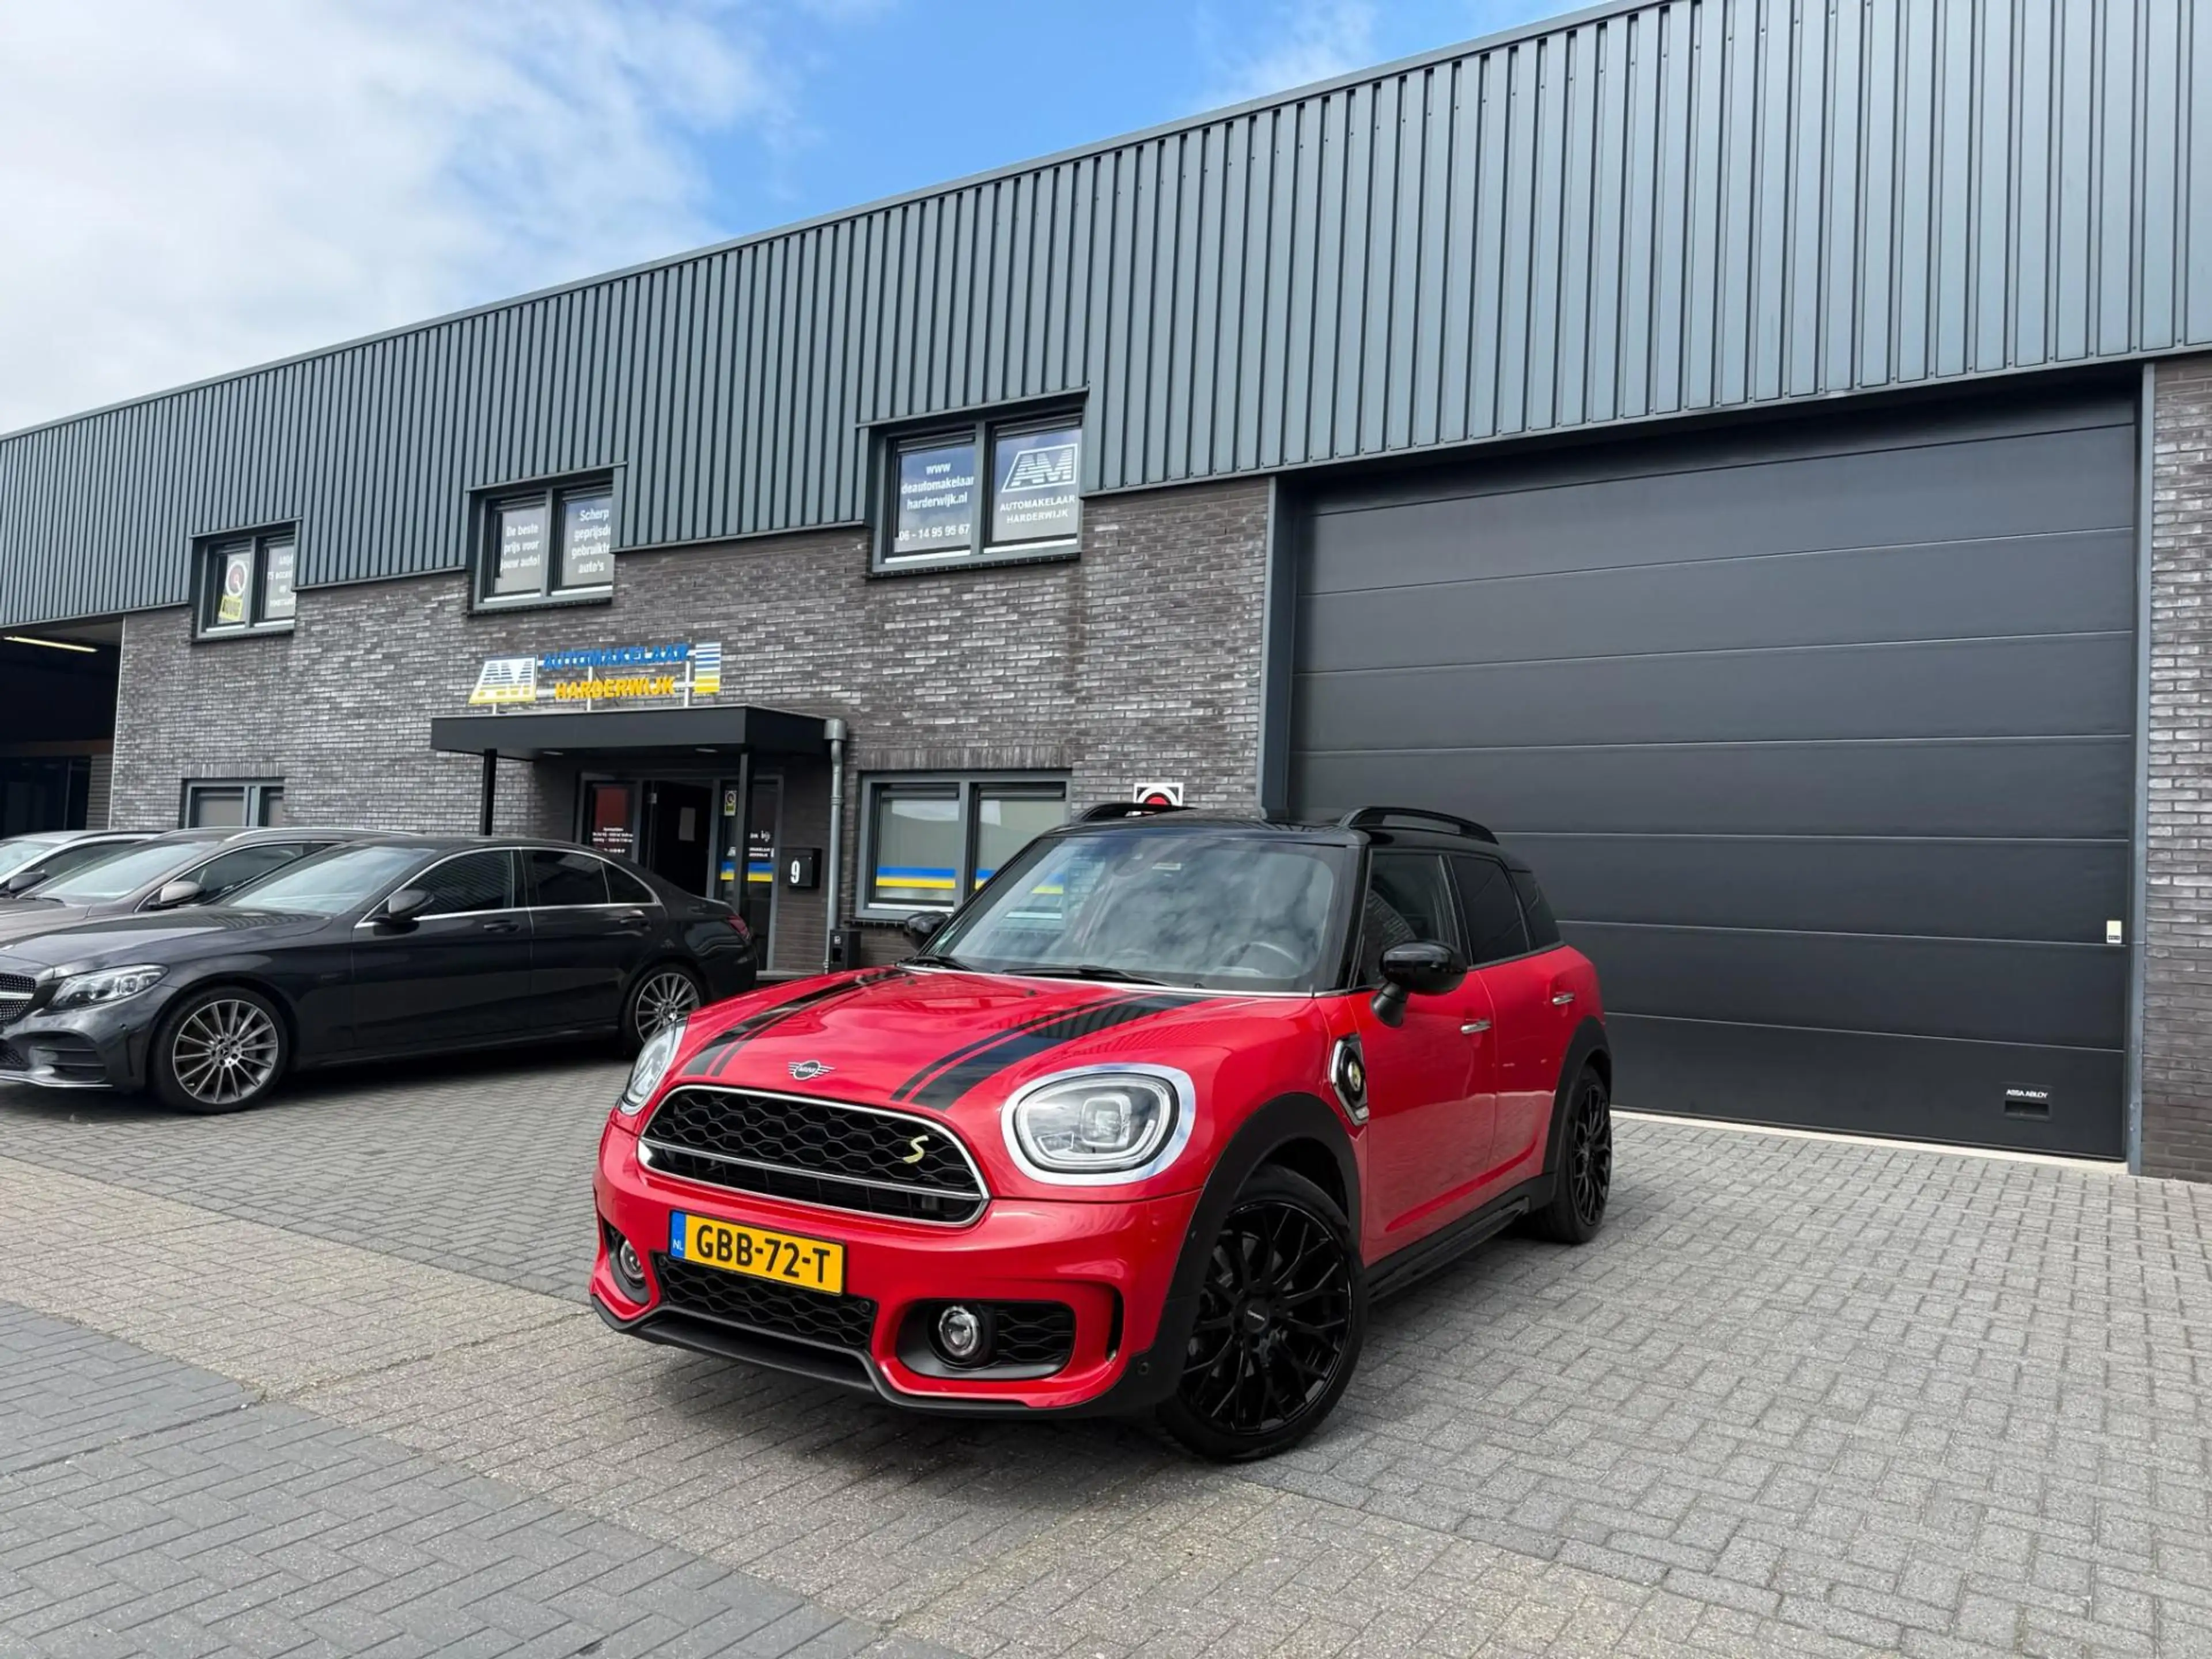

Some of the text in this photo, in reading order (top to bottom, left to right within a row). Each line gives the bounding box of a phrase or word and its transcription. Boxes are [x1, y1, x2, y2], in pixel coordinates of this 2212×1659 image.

[902, 475, 974, 495] deautomakelaar
[907, 491, 968, 511] harderwijk.nl
[999, 494, 1076, 513] AUTOMAKELAAR
[579, 507, 609, 522] Scherp
[1006, 508, 1069, 524] HARDERWIJK
[507, 522, 539, 537] De beste
[918, 528, 930, 539] 14
[503, 541, 521, 556] prijs
[578, 560, 605, 574] auto's
[543, 643, 688, 669] AUTOMAKELAAR
[555, 676, 675, 700] HARDERWIJK
[790, 860, 800, 884] 9
[903, 1135, 929, 1164] S
[673, 1239, 683, 1252] NL
[697, 1225, 830, 1283] GBB-72-T
